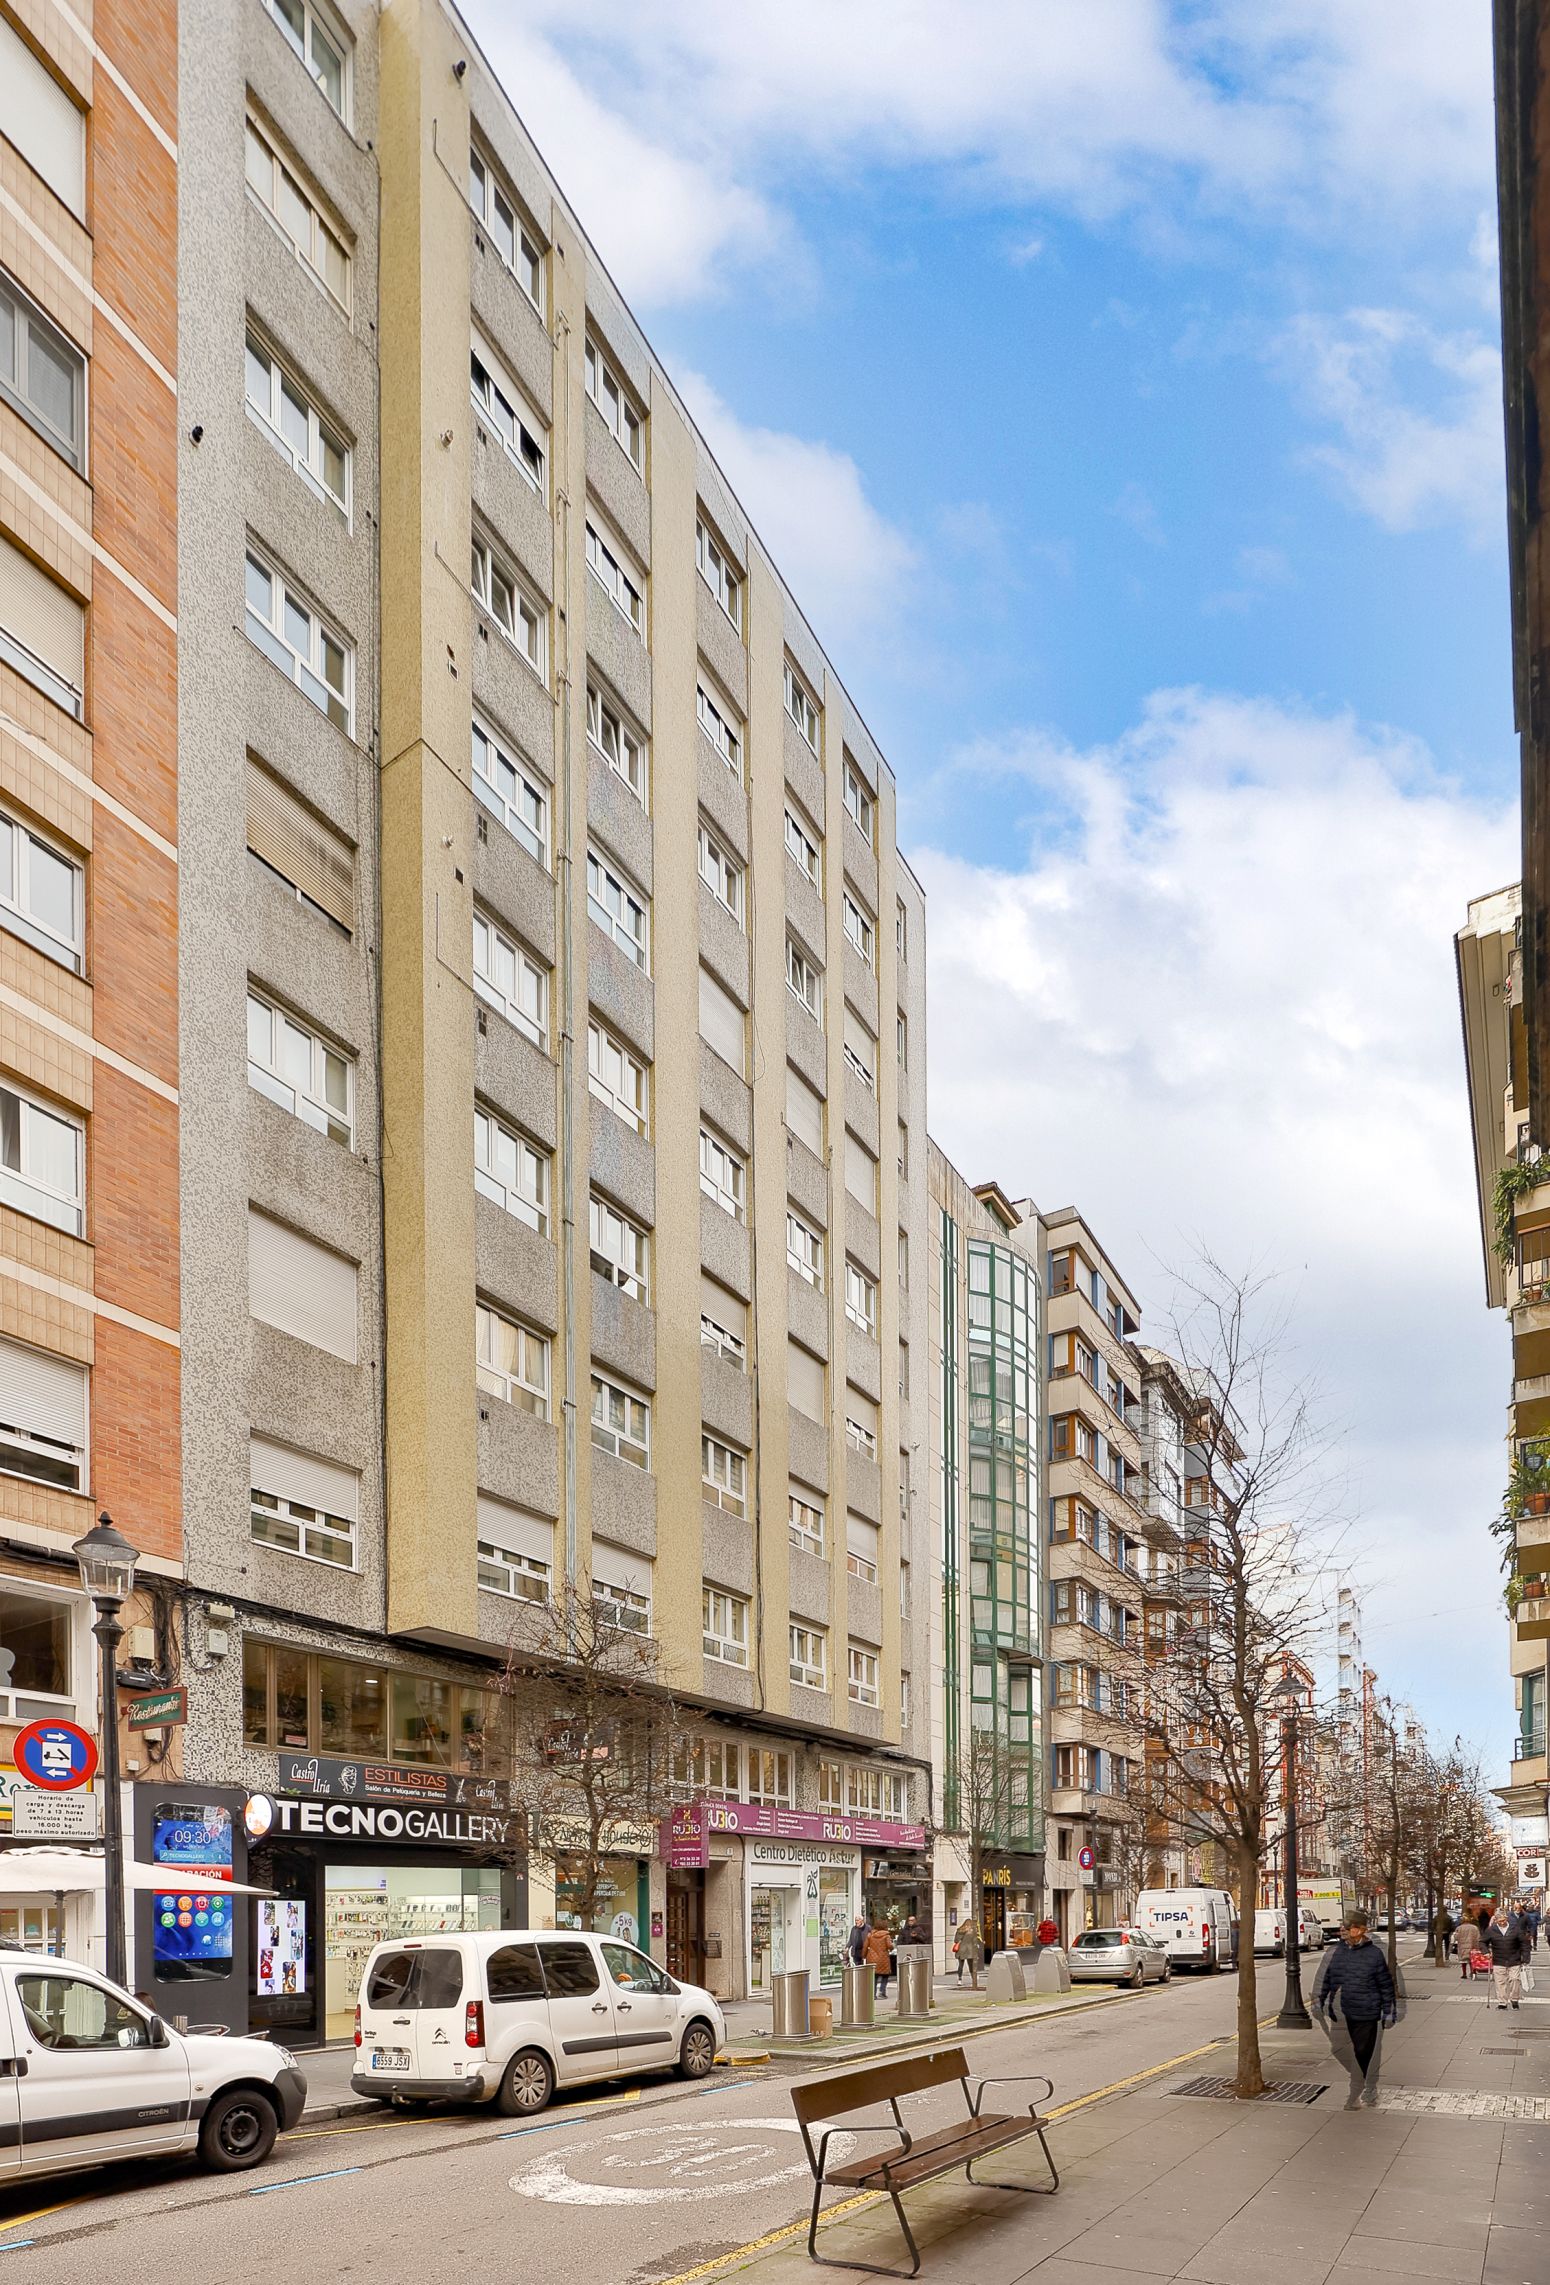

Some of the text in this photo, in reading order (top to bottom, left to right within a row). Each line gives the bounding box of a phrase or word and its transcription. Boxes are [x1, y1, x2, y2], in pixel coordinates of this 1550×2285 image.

[291, 1763, 315, 1780] Castro
[365, 1767, 447, 1788] ESTILISTAS
[365, 1784, 382, 1793] Salón
[427, 1791, 447, 1799] Belleza
[174, 1830, 211, 1844] 09:30
[754, 1843, 856, 1865] Centro Dietético Astur
[982, 1865, 1011, 1886] PANRÍS
[1153, 1911, 1189, 1922] TIPSA
[376, 2056, 408, 2067] 6559 JSX
